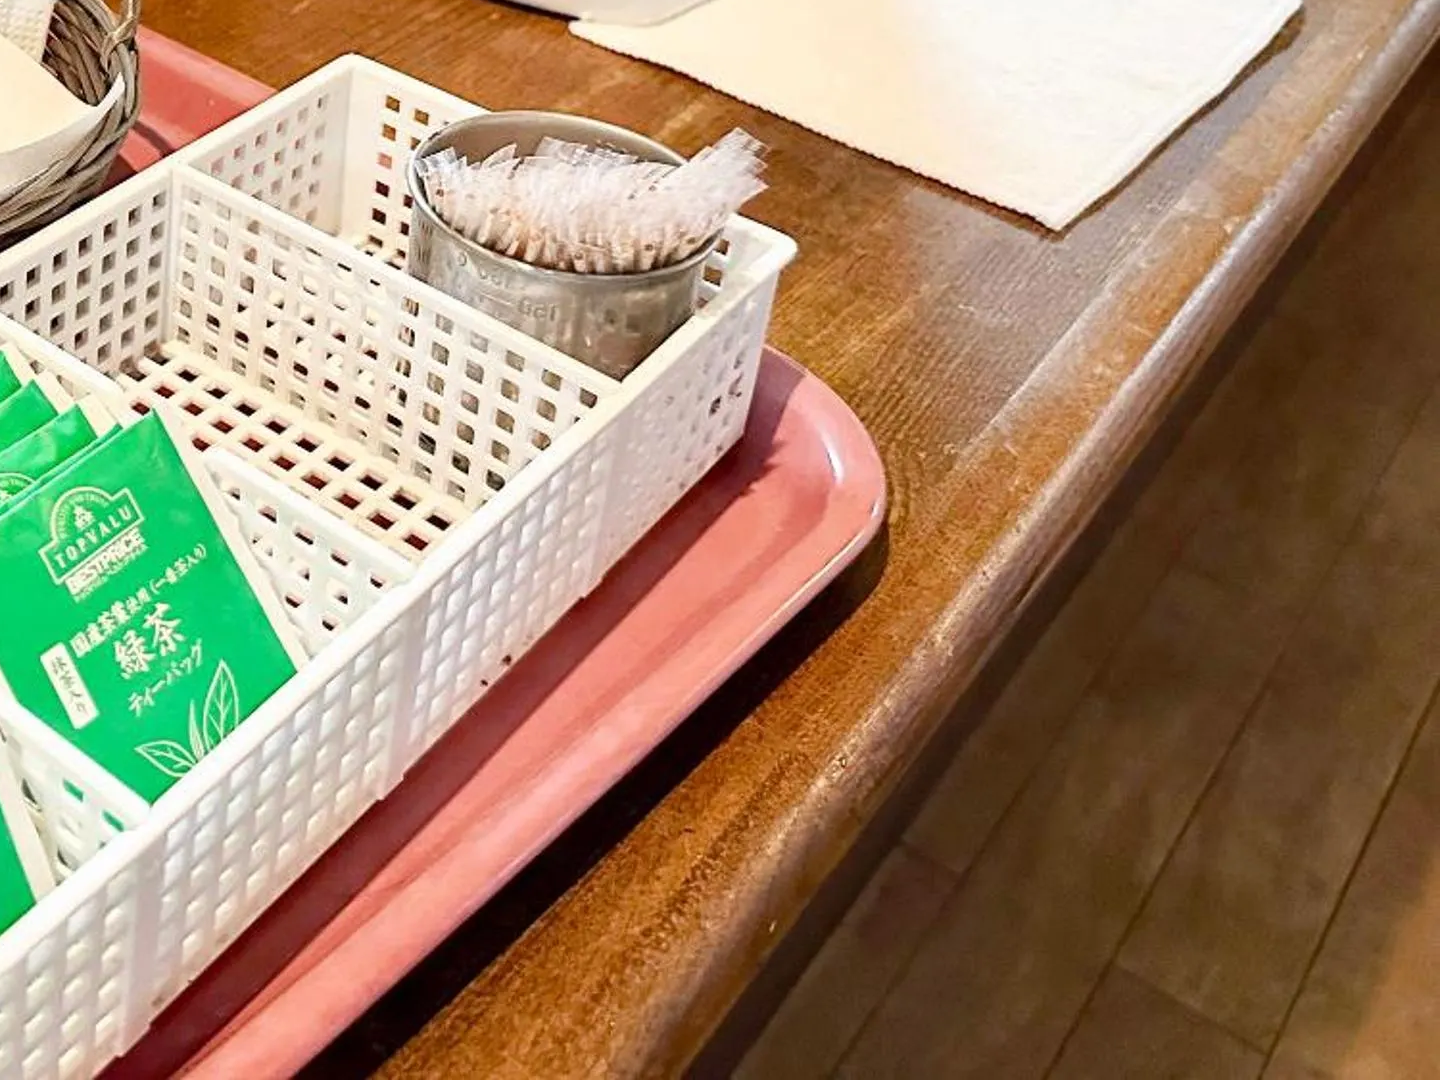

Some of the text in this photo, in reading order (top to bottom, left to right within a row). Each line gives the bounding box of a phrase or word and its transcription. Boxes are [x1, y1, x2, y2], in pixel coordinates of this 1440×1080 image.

[54, 505, 133, 569] TOPVALU
[114, 602, 186, 679] 緑茶
[127, 638, 203, 717] ティーバッグ
